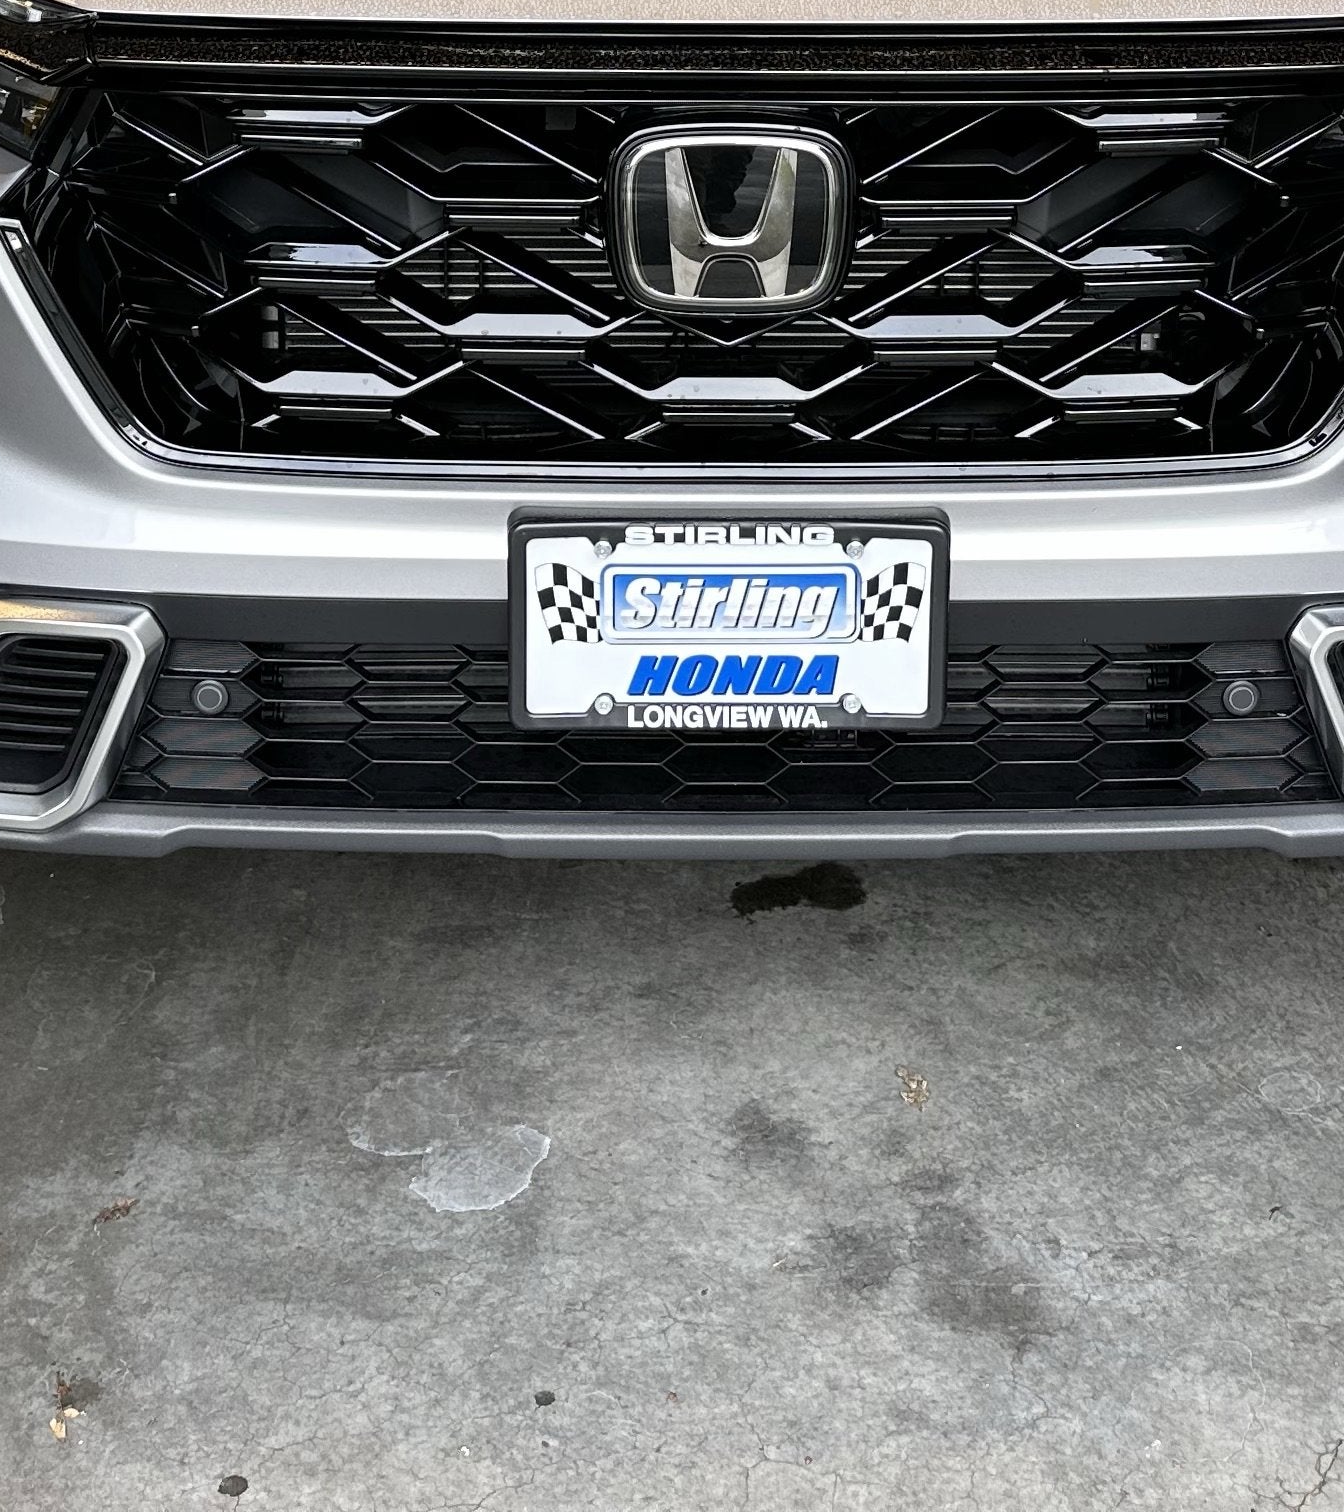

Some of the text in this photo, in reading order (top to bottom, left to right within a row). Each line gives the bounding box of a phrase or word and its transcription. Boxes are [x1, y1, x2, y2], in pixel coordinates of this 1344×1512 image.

[623, 524, 835, 546] STIRLING
[621, 577, 839, 639] Stirling
[626, 654, 840, 697] HONDA
[627, 705, 829, 729] LONGVIEW WA.
